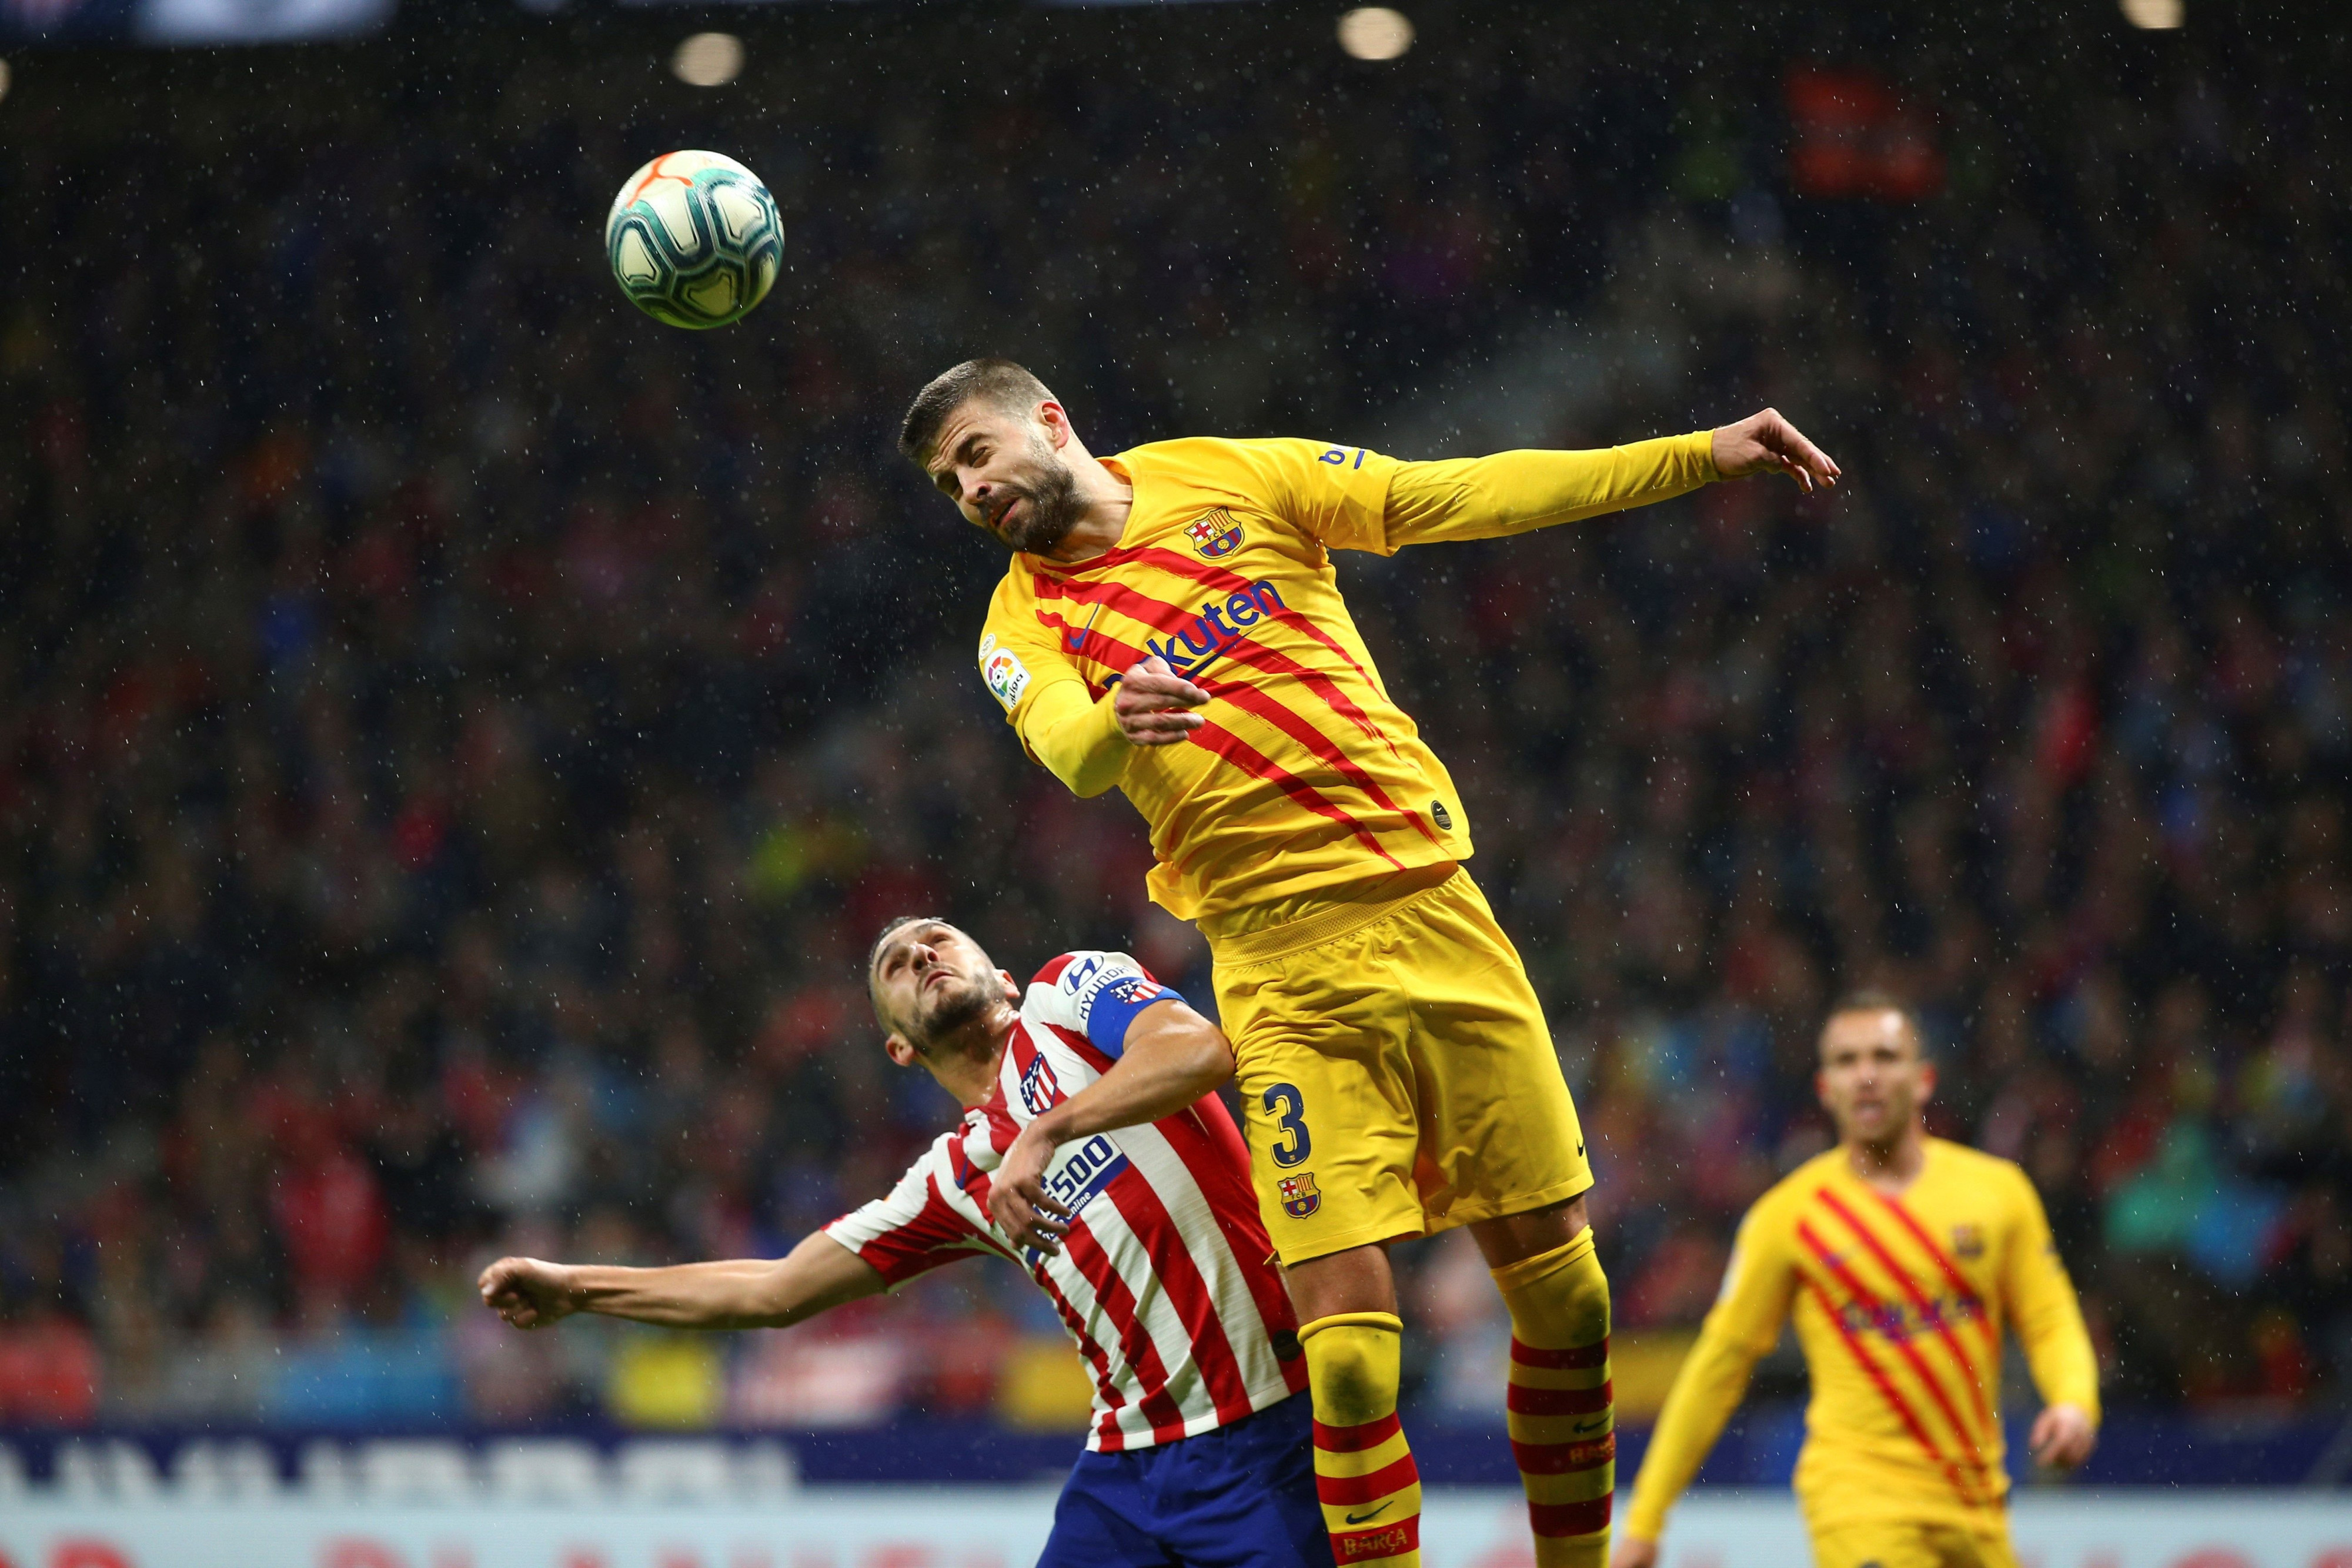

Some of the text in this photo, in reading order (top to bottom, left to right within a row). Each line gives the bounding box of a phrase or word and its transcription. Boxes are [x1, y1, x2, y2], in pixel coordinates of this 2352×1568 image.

[1102, 580, 1285, 691] kuten
[1262, 1083, 1311, 1168] 3
[1344, 1527, 1408, 1556] BARÇA
